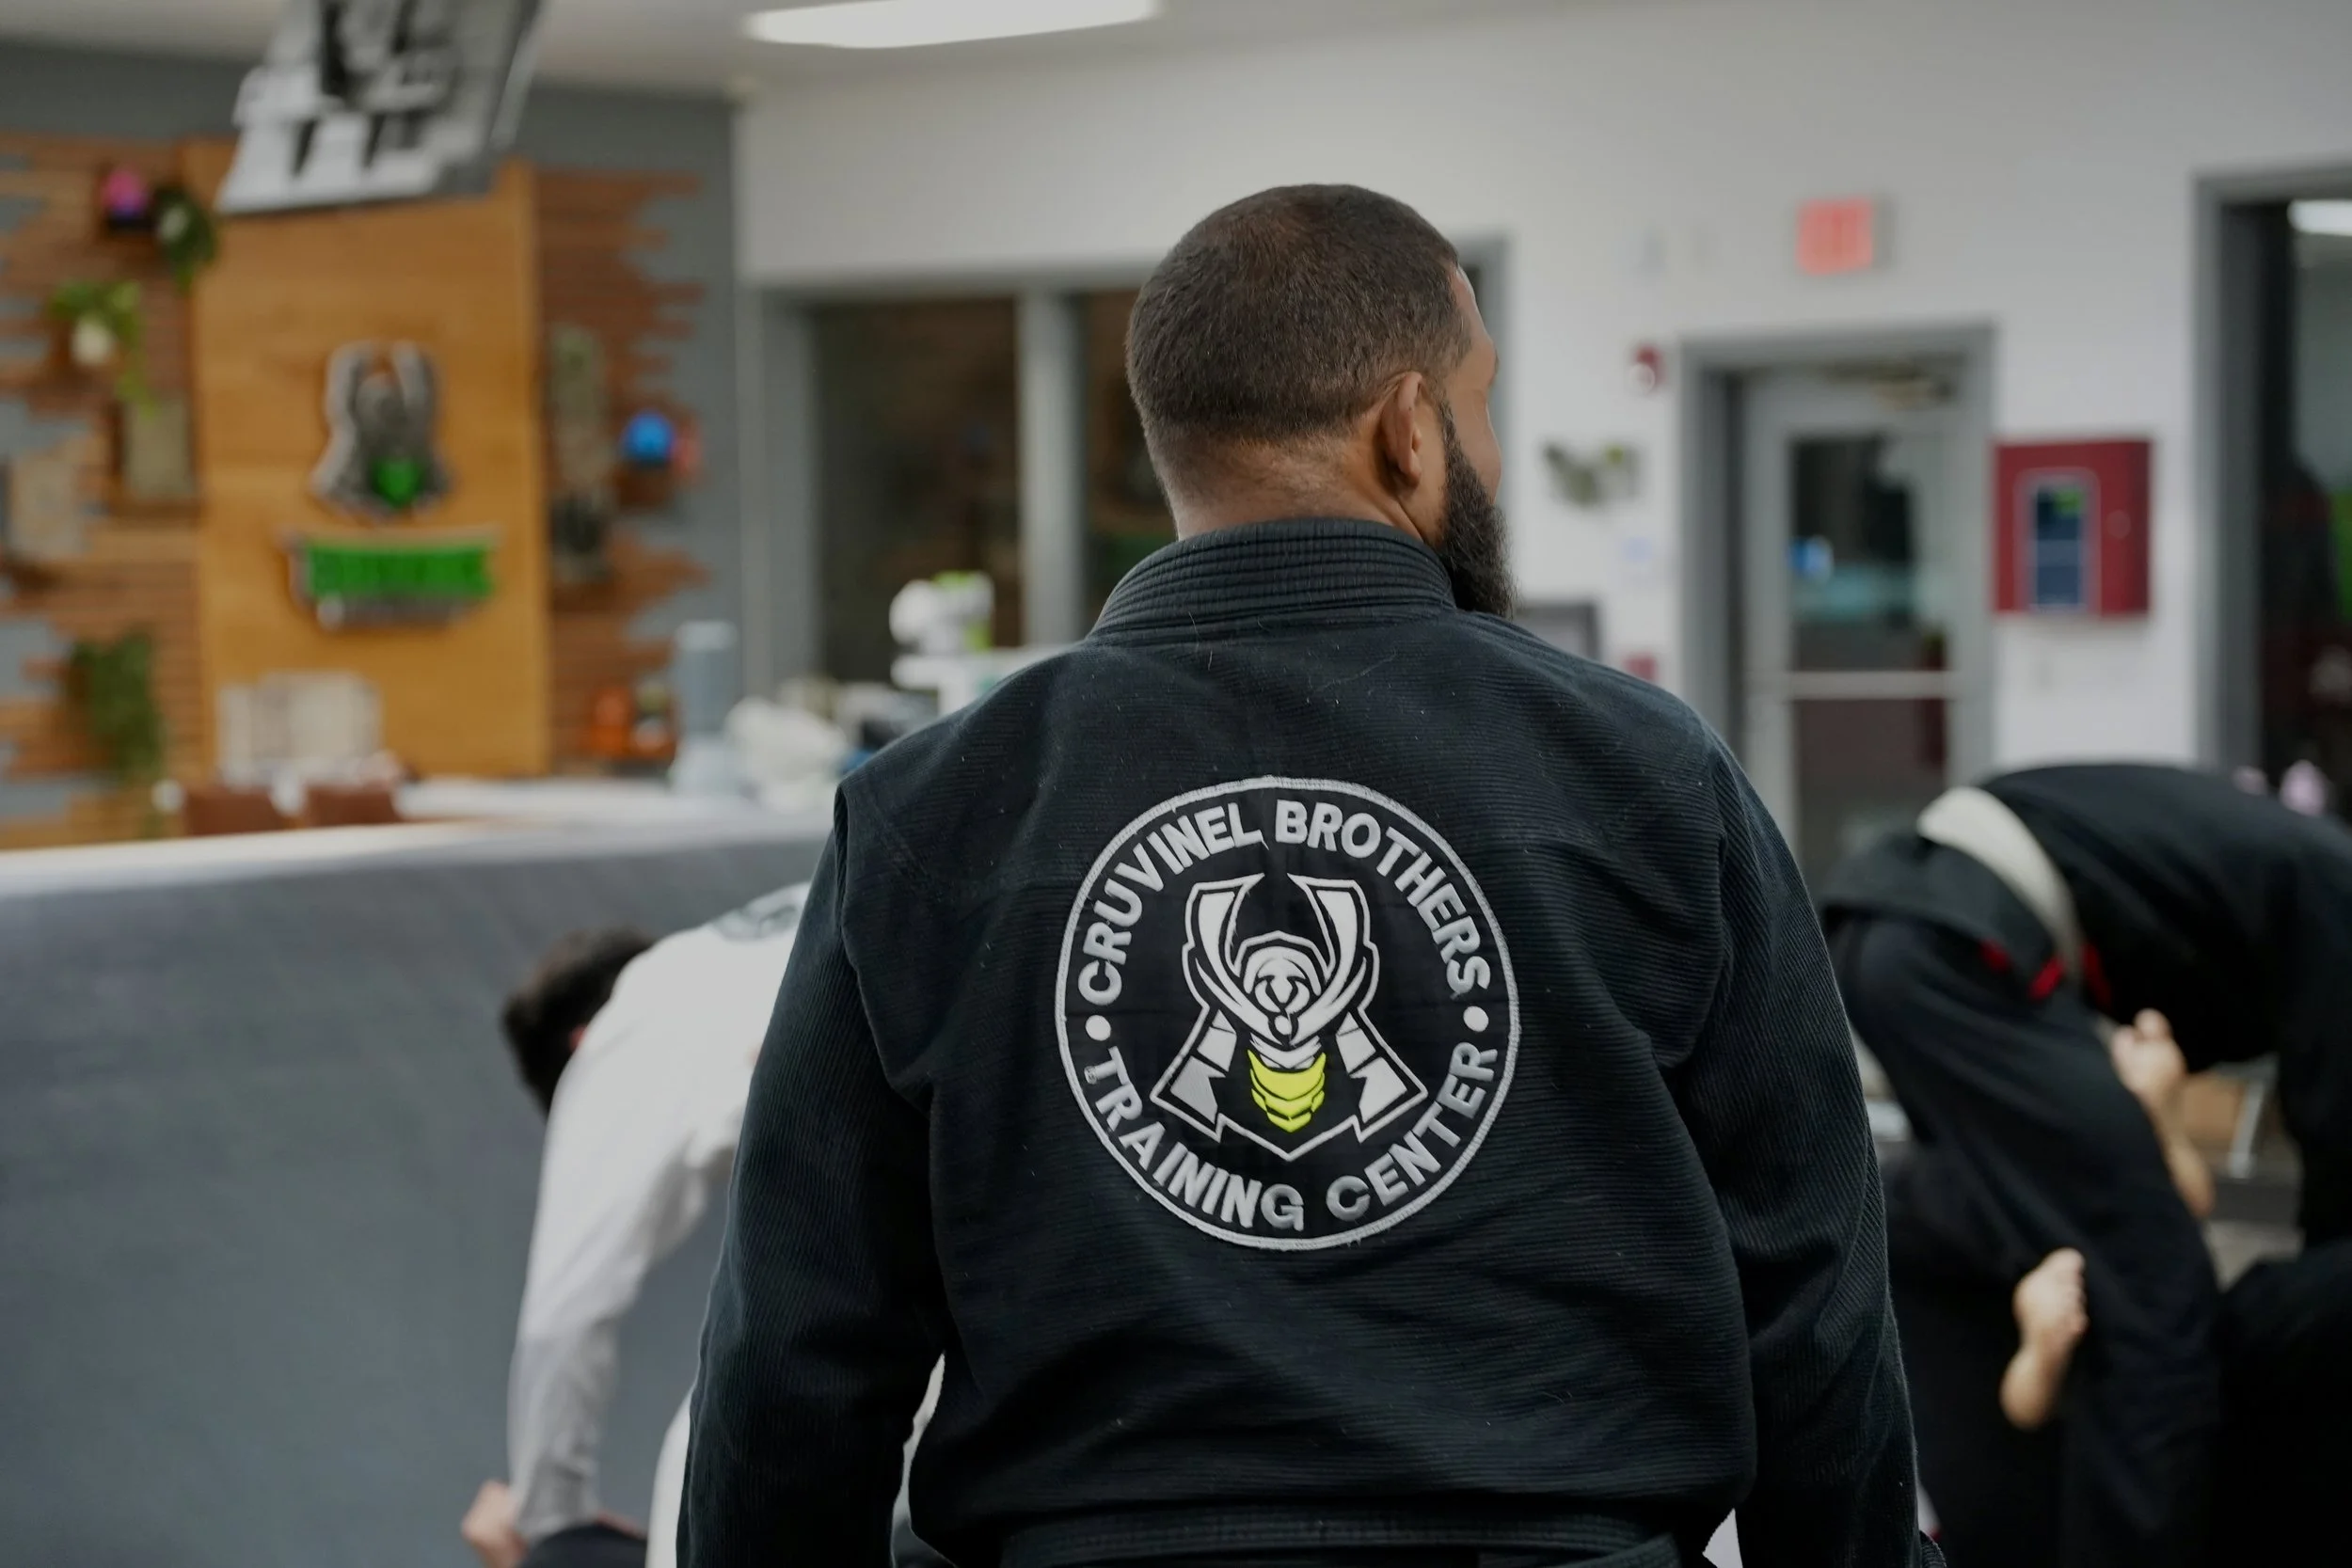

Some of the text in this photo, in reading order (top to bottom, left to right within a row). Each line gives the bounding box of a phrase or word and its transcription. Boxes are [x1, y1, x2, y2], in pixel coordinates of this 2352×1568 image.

[1077, 799, 1492, 1006] CRUVINEL BROTHERS
[1083, 1041, 1499, 1231] TRAINING CENTER
